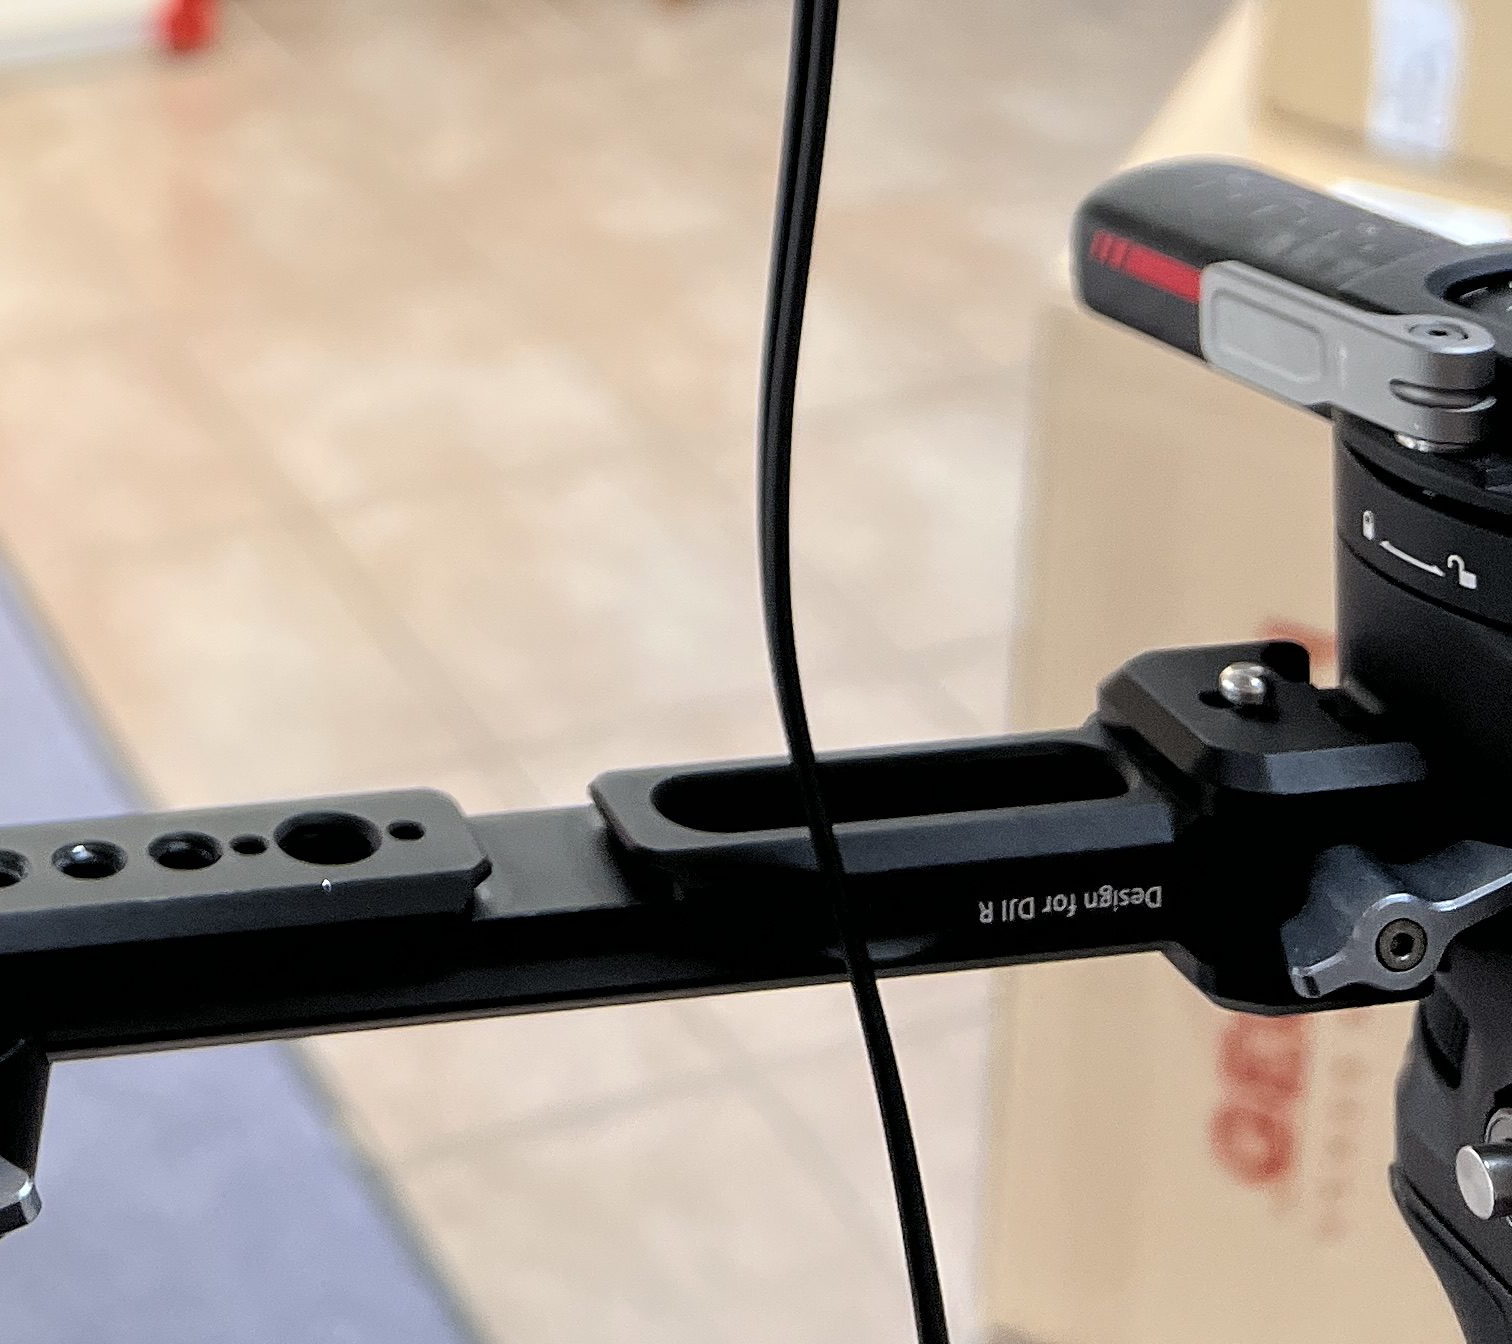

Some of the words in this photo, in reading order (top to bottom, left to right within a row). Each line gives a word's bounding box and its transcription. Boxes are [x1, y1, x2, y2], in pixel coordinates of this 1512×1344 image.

[1001, 897, 1036, 922] DJI
[1042, 893, 1077, 918] for
[1084, 885, 1163, 912] Design
[978, 901, 994, 924] R
